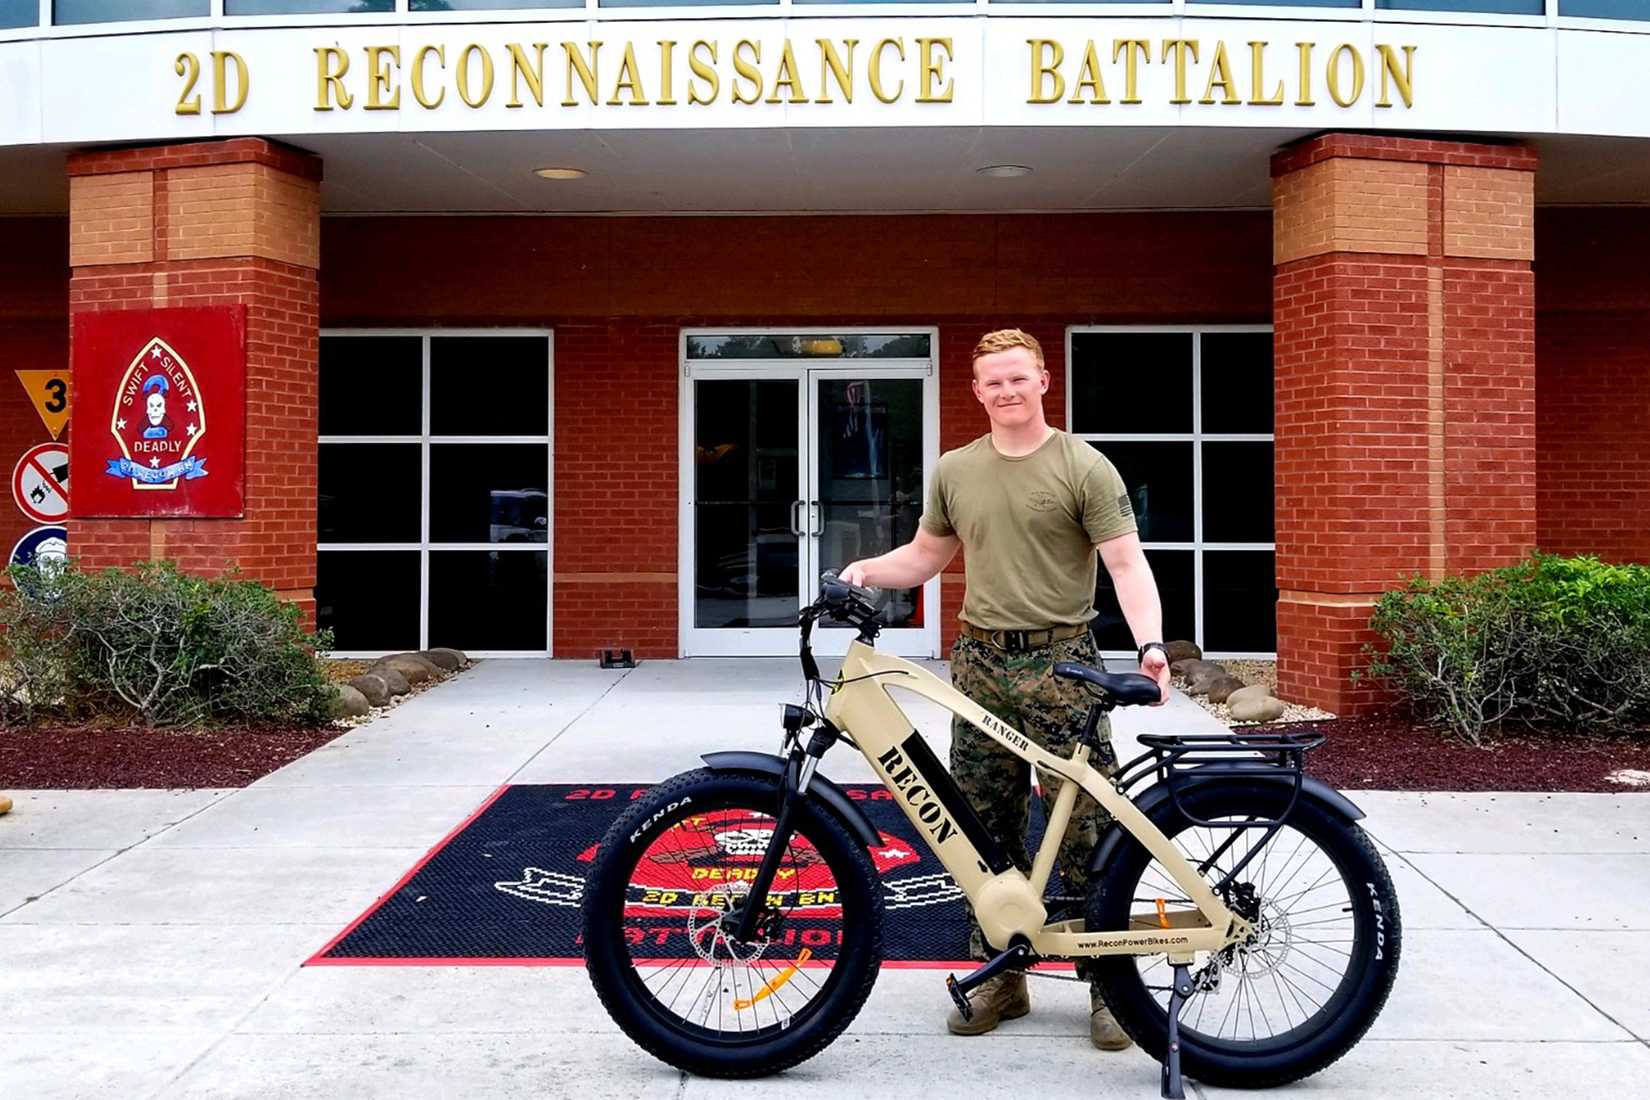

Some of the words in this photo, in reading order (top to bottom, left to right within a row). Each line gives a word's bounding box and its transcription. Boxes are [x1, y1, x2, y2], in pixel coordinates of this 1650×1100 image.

[175, 51, 249, 116] 2D
[314, 38, 953, 110] RECONNAISSANCE
[1026, 38, 1417, 109] BATTALION
[45, 378, 67, 413] 3
[123, 361, 149, 406] SWIFT
[160, 356, 193, 398] SILENT
[134, 441, 182, 452] DEADLY
[981, 714, 1030, 751] RANGER
[564, 789, 617, 800] 2D
[877, 745, 958, 845] RECON
[629, 796, 693, 844] KENDA
[691, 868, 796, 880] DEADY
[643, 891, 678, 904] 2D
[799, 892, 834, 906] BN
[1366, 882, 1385, 960] KENDA
[1078, 936, 1189, 949] www.ReconPowerBikes.com
